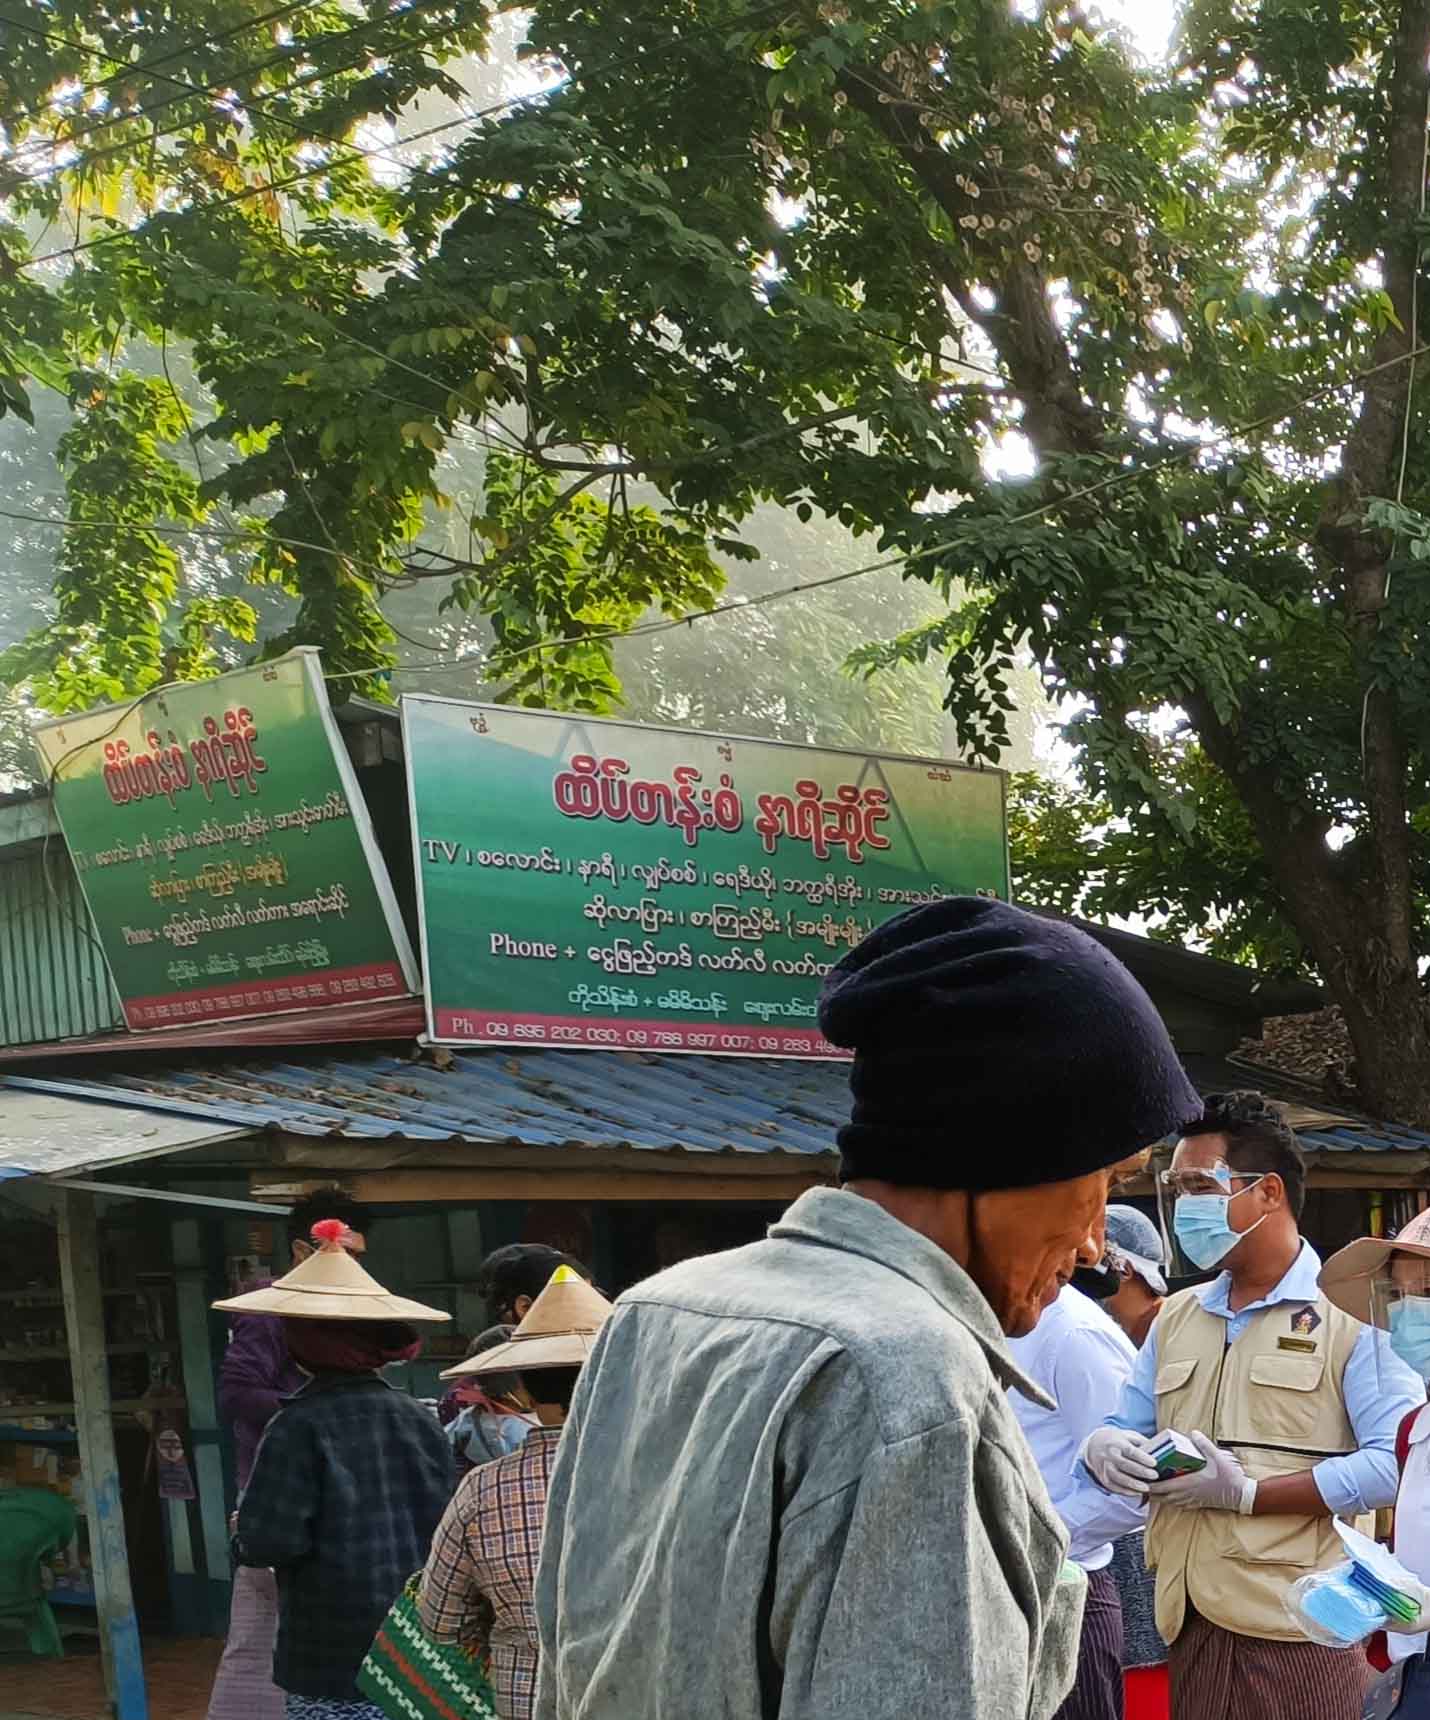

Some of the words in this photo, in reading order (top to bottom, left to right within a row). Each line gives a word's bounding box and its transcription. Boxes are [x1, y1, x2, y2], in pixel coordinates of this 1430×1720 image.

[553, 753, 743, 846] ထိပ်တန်းစံ
[423, 839, 460, 861] TV
[489, 932, 557, 958] Phone
[486, 1022, 509, 1037] 09
[551, 1026, 583, 1041] 202
